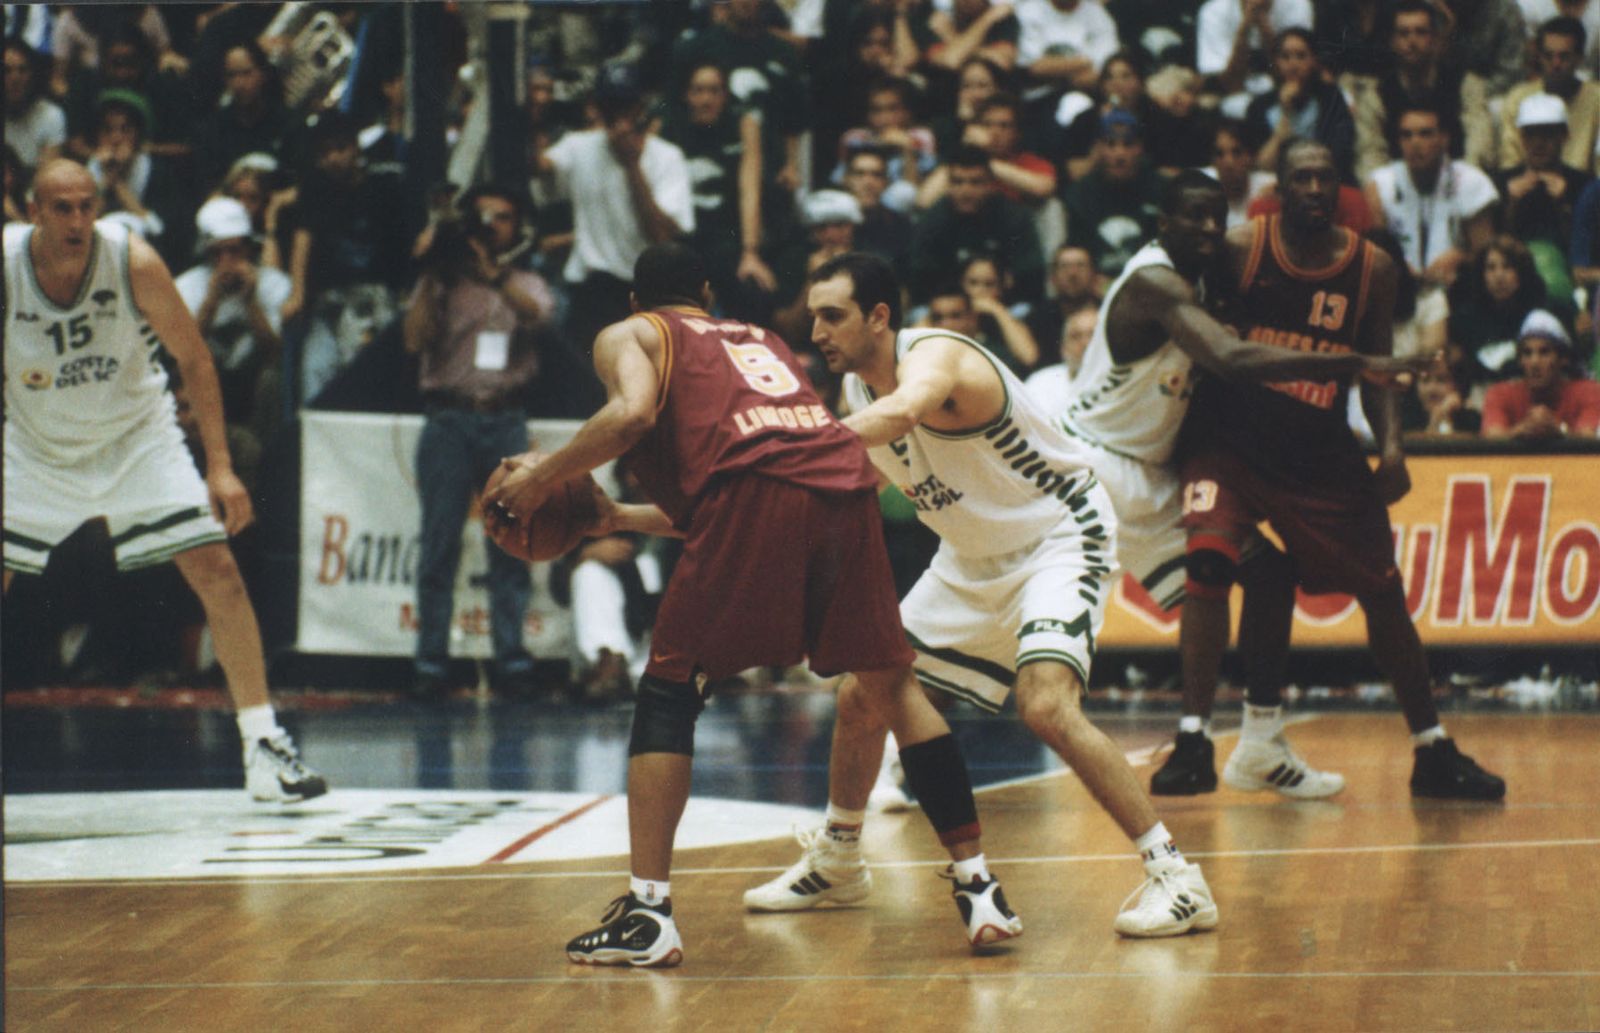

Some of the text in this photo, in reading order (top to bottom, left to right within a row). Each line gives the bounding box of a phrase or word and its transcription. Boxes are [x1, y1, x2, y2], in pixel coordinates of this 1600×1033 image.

[1308, 290, 1348, 330] 13
[45, 313, 93, 356] 15
[60, 356, 119, 376] COSTA
[720, 338, 800, 397] 5
[733, 404, 841, 436] LIMOGE
[931, 488, 964, 511] SOL
[1182, 479, 1219, 515] 13
[1033, 620, 1067, 634] FILA
